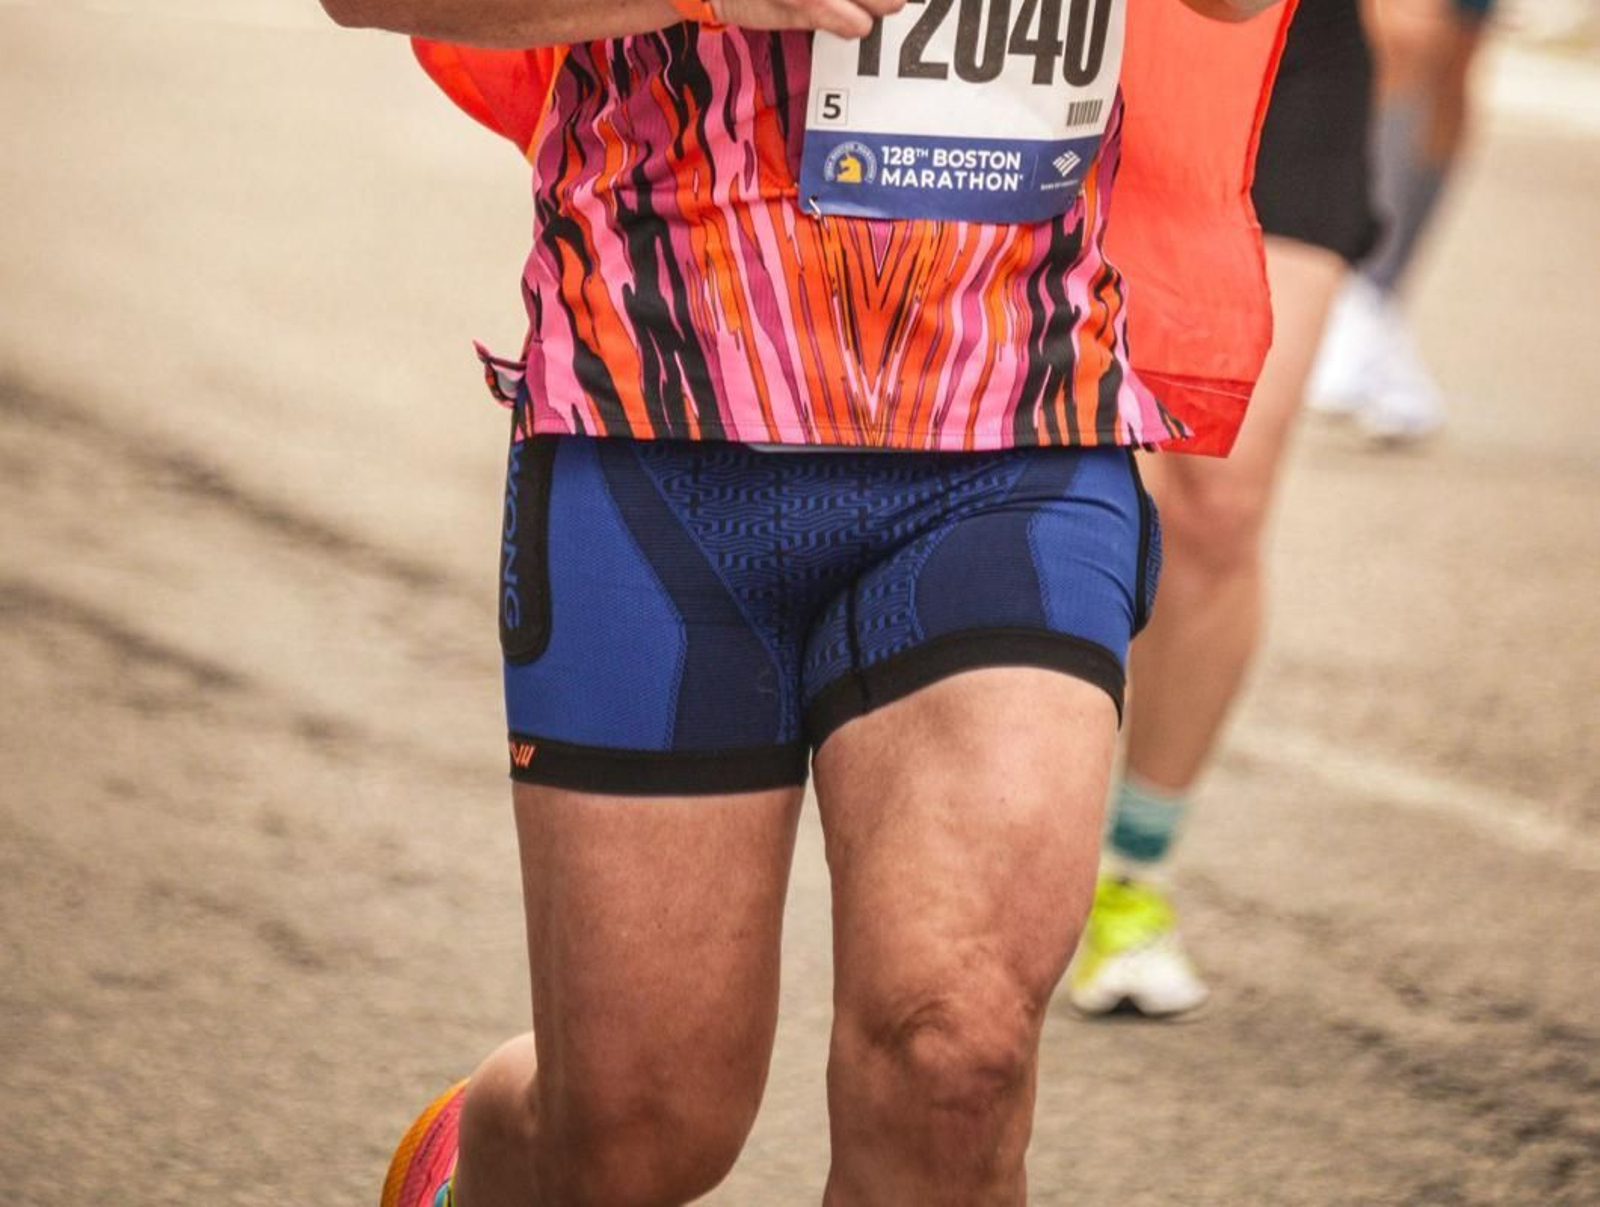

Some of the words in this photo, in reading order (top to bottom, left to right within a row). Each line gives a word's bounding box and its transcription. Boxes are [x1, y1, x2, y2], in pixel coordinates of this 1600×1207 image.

[822, 94, 842, 120] 5
[881, 146, 929, 166] 128TH
[932, 148, 1021, 170] BOSTON
[881, 167, 1020, 191] MARATHON
